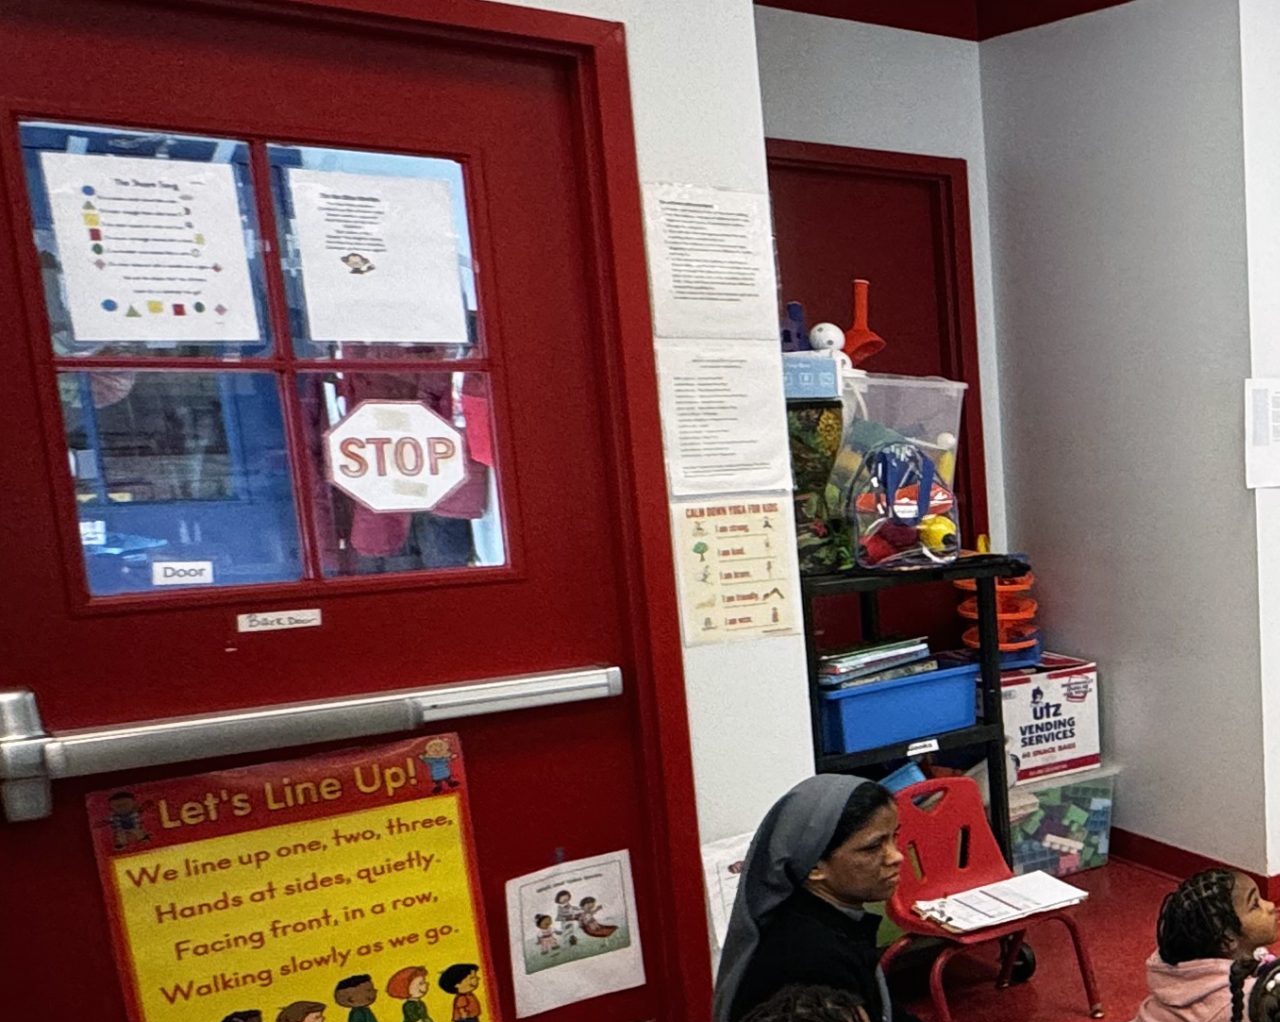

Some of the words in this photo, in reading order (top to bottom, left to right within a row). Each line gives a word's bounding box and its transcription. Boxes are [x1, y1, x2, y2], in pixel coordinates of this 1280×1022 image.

[339, 436, 457, 478] STOP
[163, 566, 206, 579] Door
[1020, 717, 1075, 736] VENDING
[1021, 728, 1076, 748] SERVICES
[159, 789, 251, 829] Let's
[264, 777, 343, 811] Line
[354, 757, 417, 796] Up!
[126, 864, 179, 888] We
[185, 858, 232, 877] line
[238, 850, 271, 869] up
[276, 840, 327, 857] one,
[332, 829, 381, 846] two,
[386, 815, 453, 835] three,
[155, 891, 243, 924] Hands
[250, 881, 276, 902] at
[285, 872, 351, 896] sides,
[357, 850, 441, 884] quietly.
[175, 931, 265, 961] Facing
[270, 909, 338, 938] front,
[344, 906, 365, 922] in
[370, 903, 385, 915] a
[392, 892, 438, 910] row,
[160, 968, 273, 1005] Walking
[280, 946, 351, 976] slowly
[357, 941, 384, 956] as
[389, 933, 419, 948] we
[425, 925, 459, 945] go.
